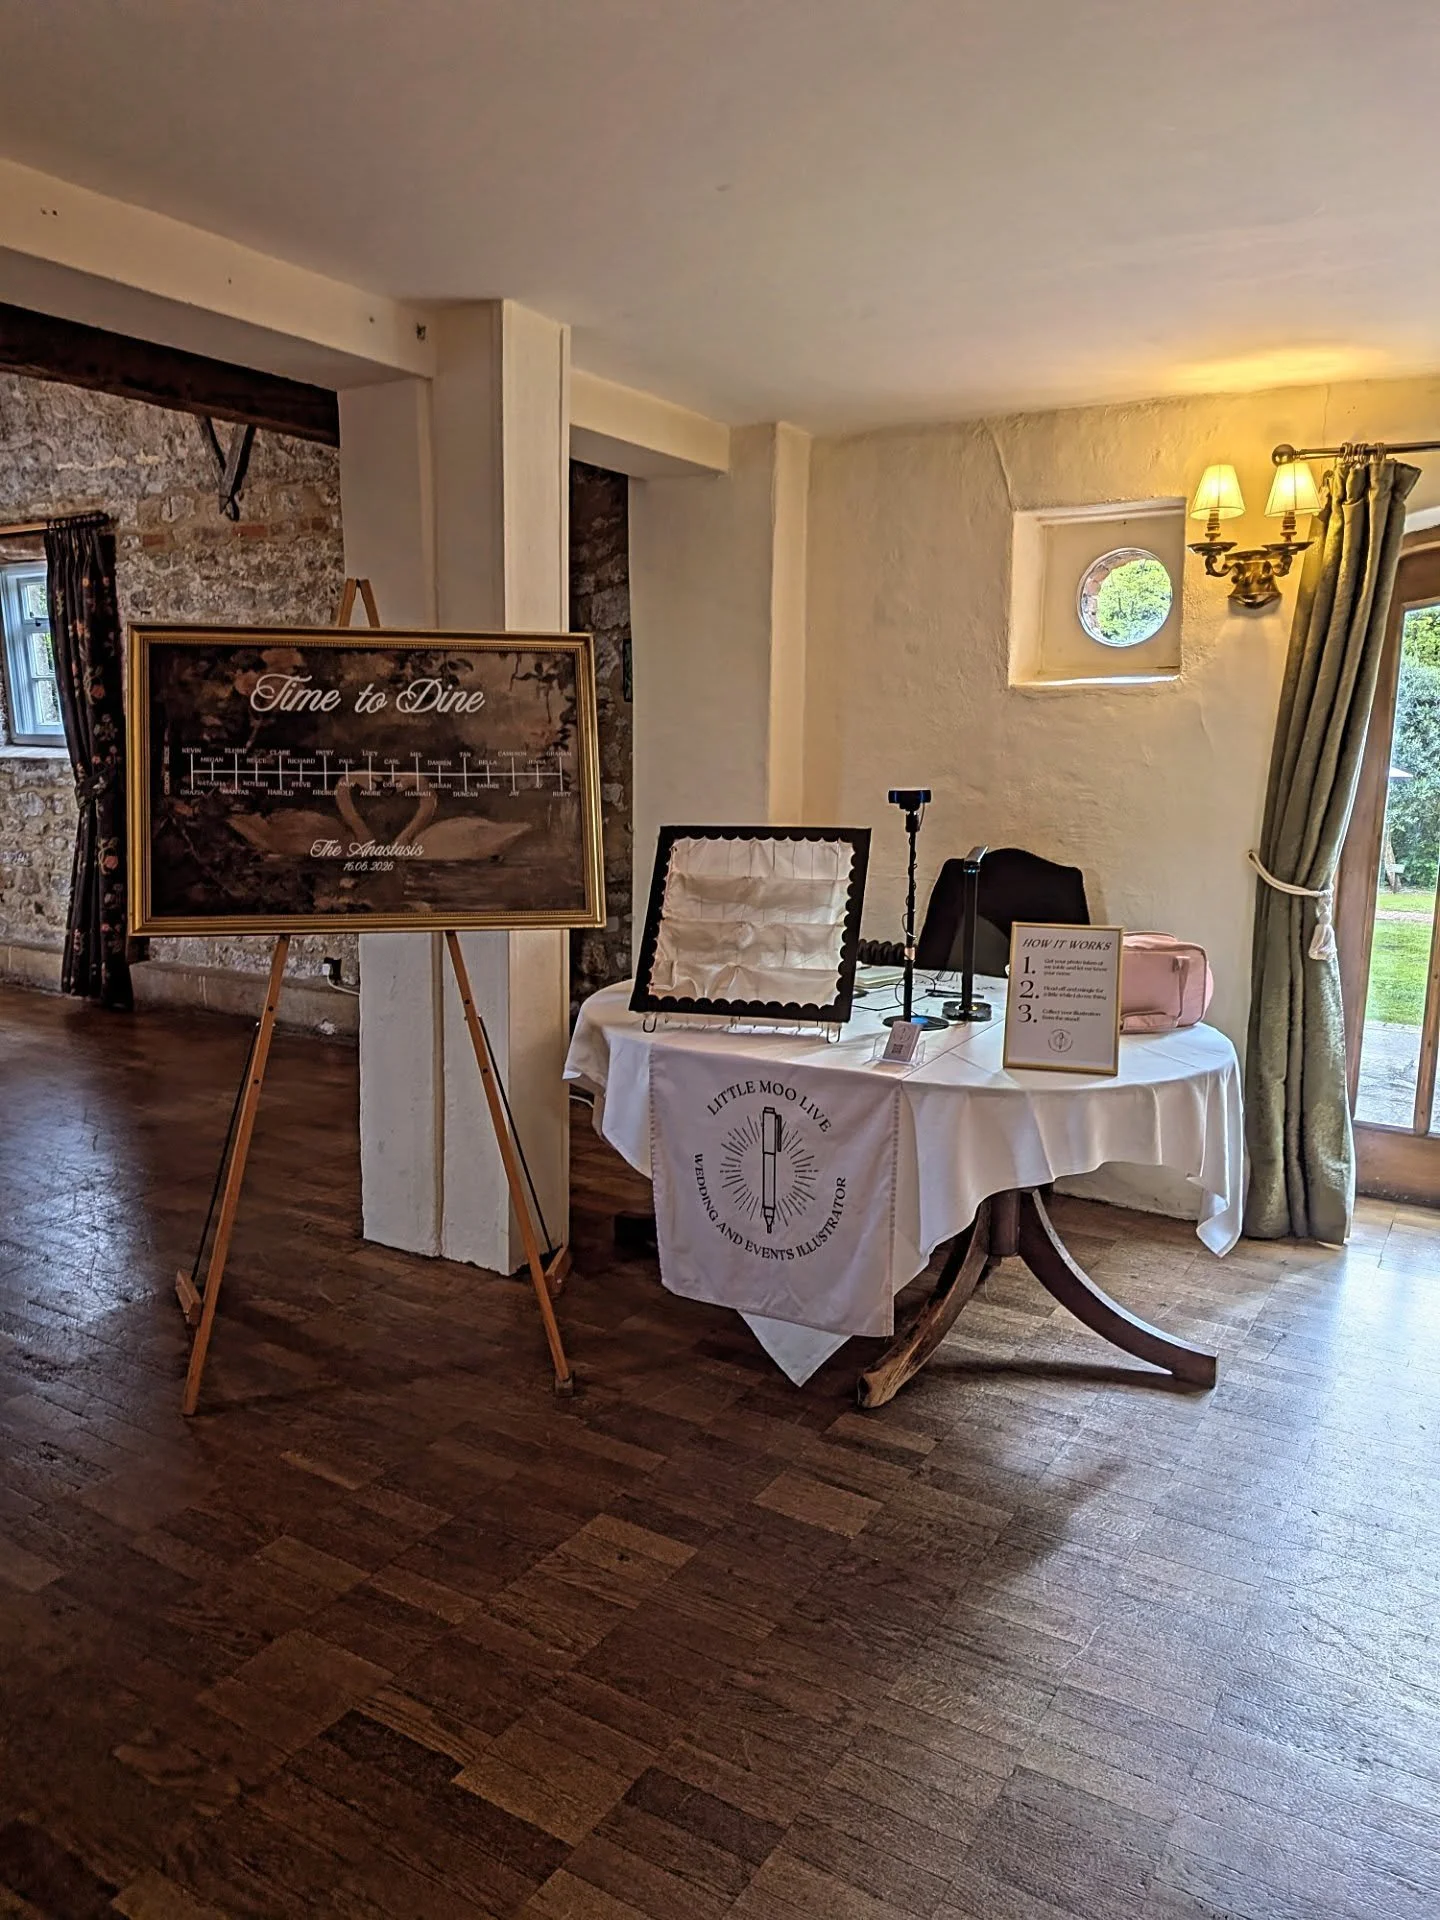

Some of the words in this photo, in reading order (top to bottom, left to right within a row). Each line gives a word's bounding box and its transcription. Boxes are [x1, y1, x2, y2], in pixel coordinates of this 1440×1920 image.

[250, 673, 341, 712] Time
[354, 683, 388, 713] to
[395, 678, 486, 714] Dine
[267, 789, 294, 797] HAROLD
[310, 839, 342, 857] The
[1022, 938, 1052, 949] HOW
[1053, 939, 1067, 949] IT
[1069, 940, 1112, 951] WORKS
[1023, 956, 1036, 974] 1.
[1019, 980, 1039, 999] 2.
[1018, 1004, 1037, 1023] 3.
[707, 1080, 756, 1115] LITTLE
[760, 1080, 797, 1101] MOO
[799, 1096, 832, 1133] LIVE
[694, 1153, 719, 1221] WEDDING
[716, 1222, 743, 1245] AND
[745, 1239, 795, 1261] EVENTS
[796, 1177, 846, 1258] ILLUSTRATOR
